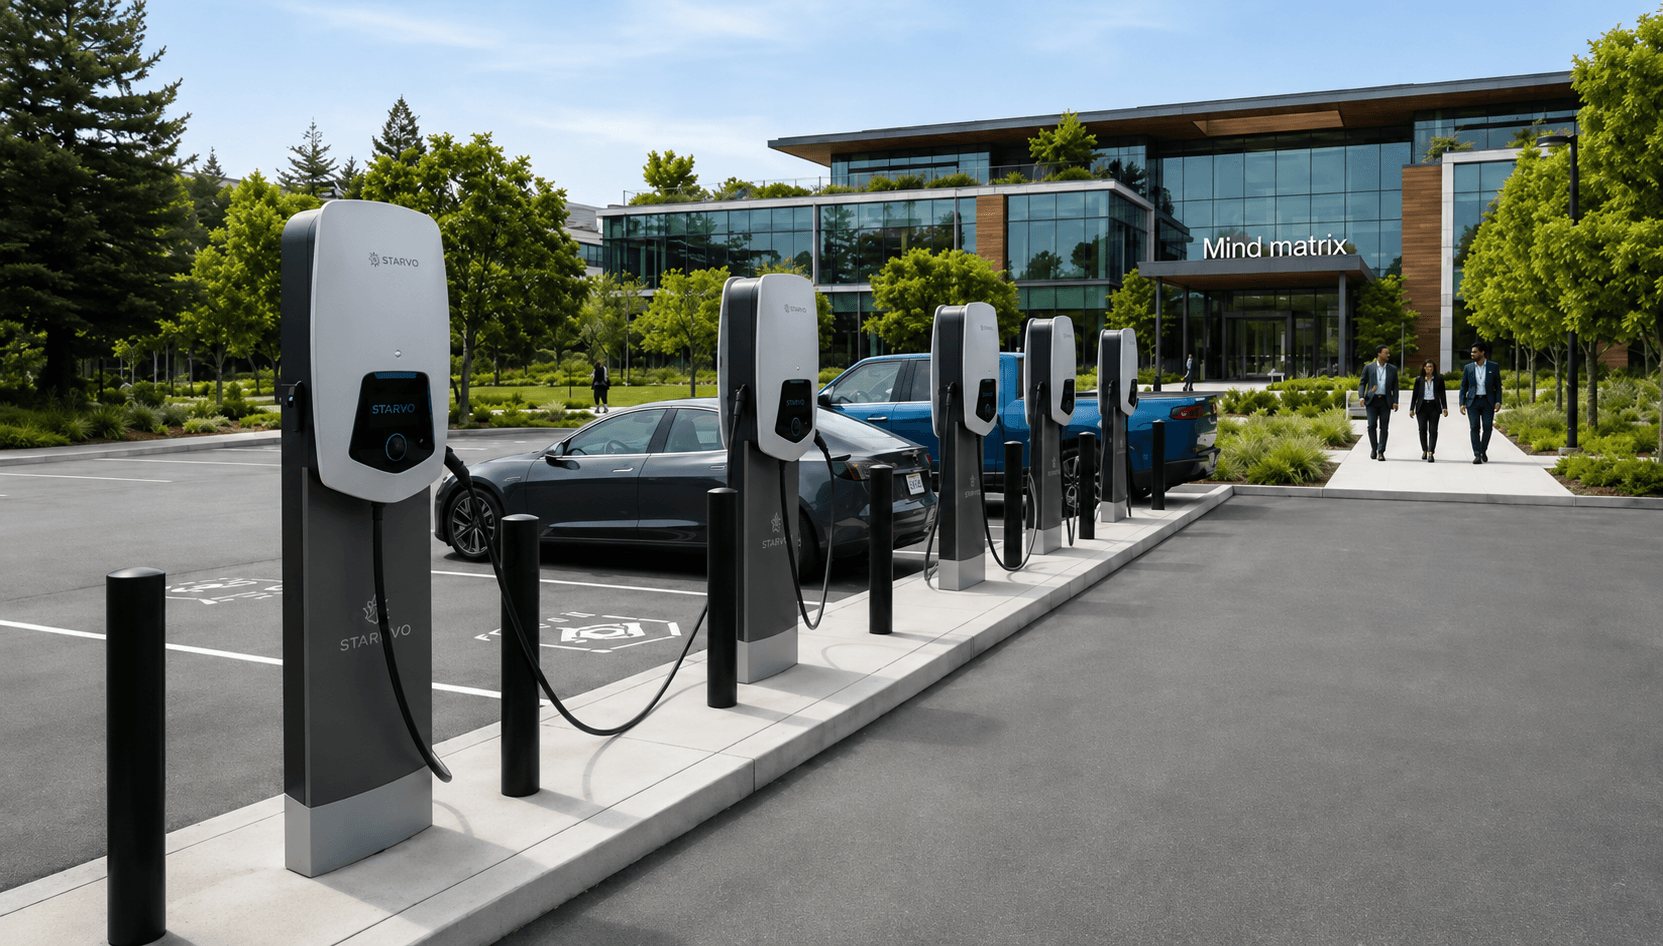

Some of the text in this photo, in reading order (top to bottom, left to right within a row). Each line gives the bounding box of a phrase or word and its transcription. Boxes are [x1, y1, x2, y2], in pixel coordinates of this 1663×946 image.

[1203, 233, 1348, 260] Mind matrix
[382, 256, 419, 268] STARVO
[372, 403, 415, 414] STARVO
